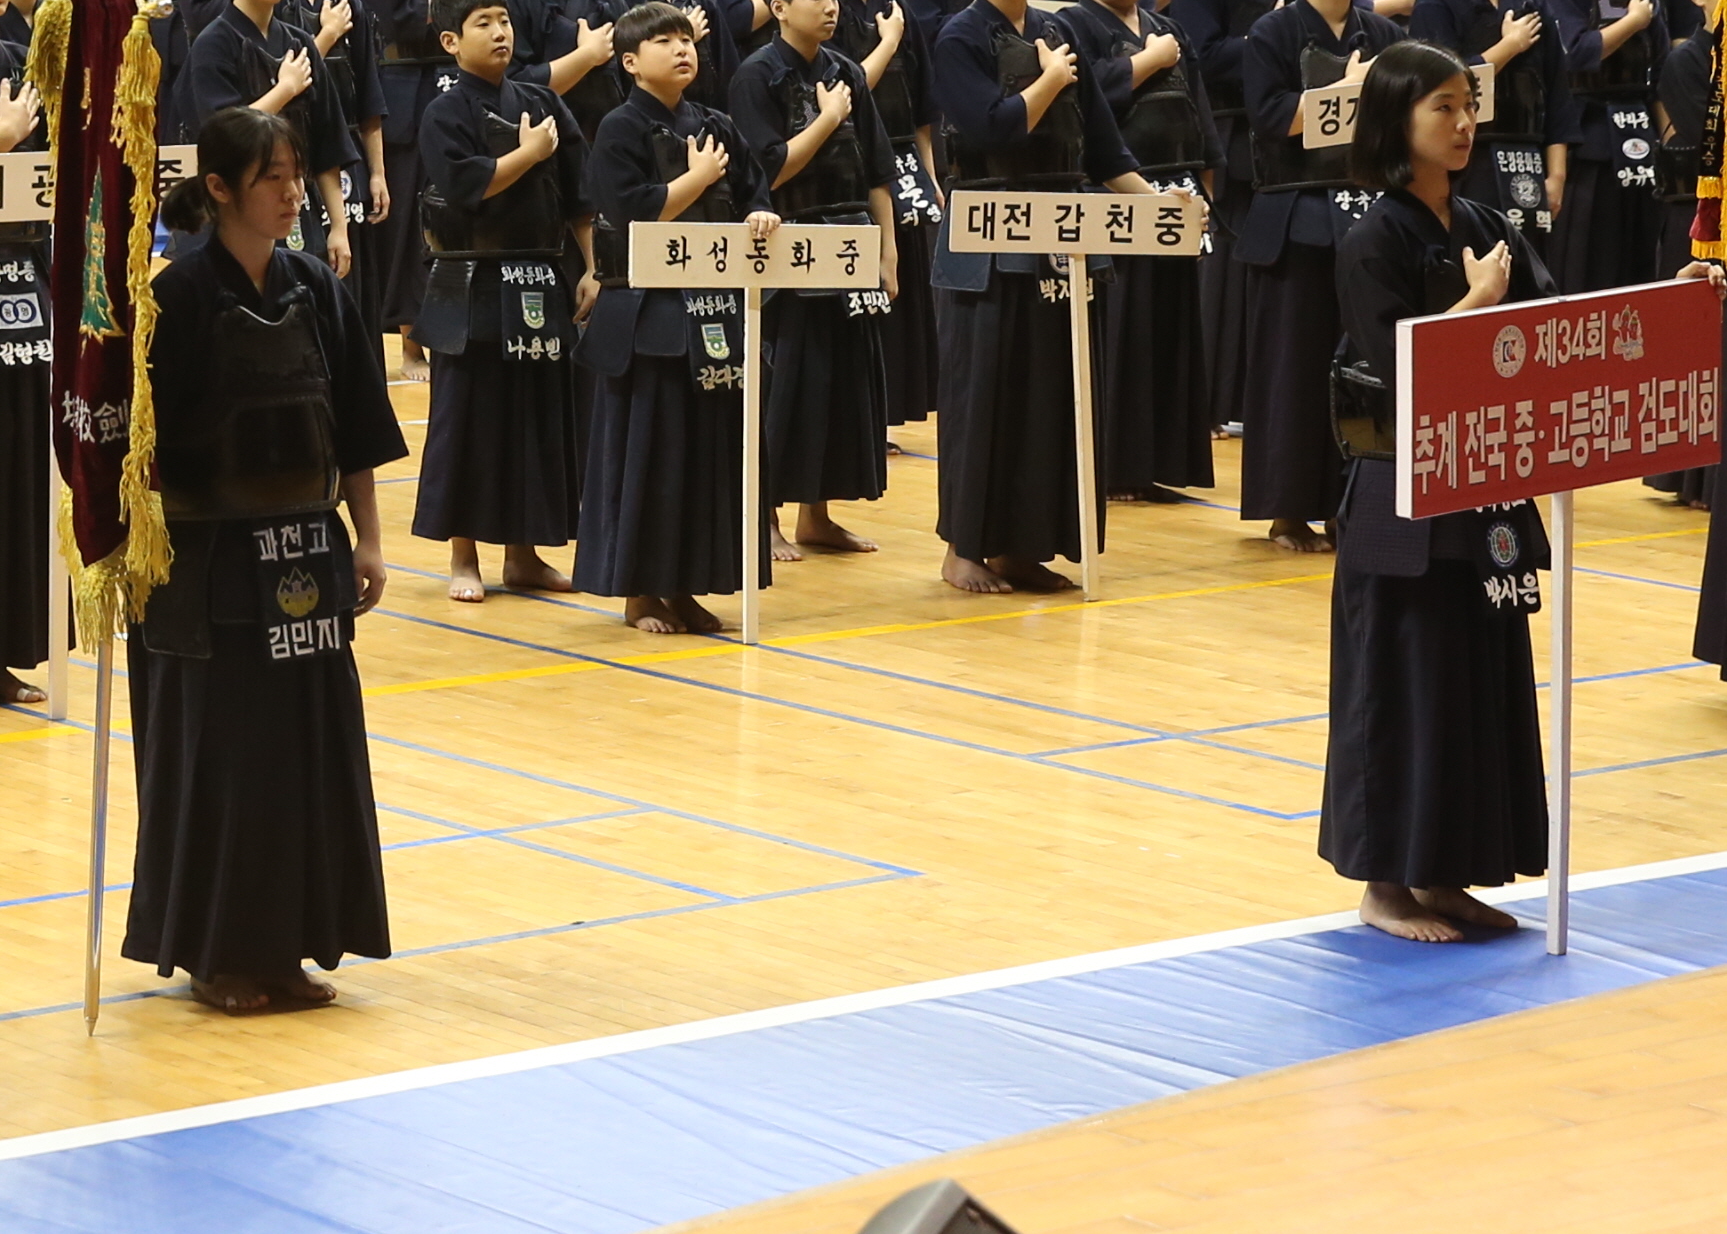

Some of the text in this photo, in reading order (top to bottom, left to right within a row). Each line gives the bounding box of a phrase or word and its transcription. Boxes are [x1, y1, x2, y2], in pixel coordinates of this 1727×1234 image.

[968, 202, 1032, 244] 대전
[1534, 309, 1608, 368] 제34회
[1414, 411, 1458, 495] 추계
[1464, 404, 1507, 485] 전국
[1637, 366, 1719, 455] 검도대회
[253, 521, 330, 561] 과천고
[1483, 571, 1540, 609] 박시은
[268, 616, 341, 660] 김민지
